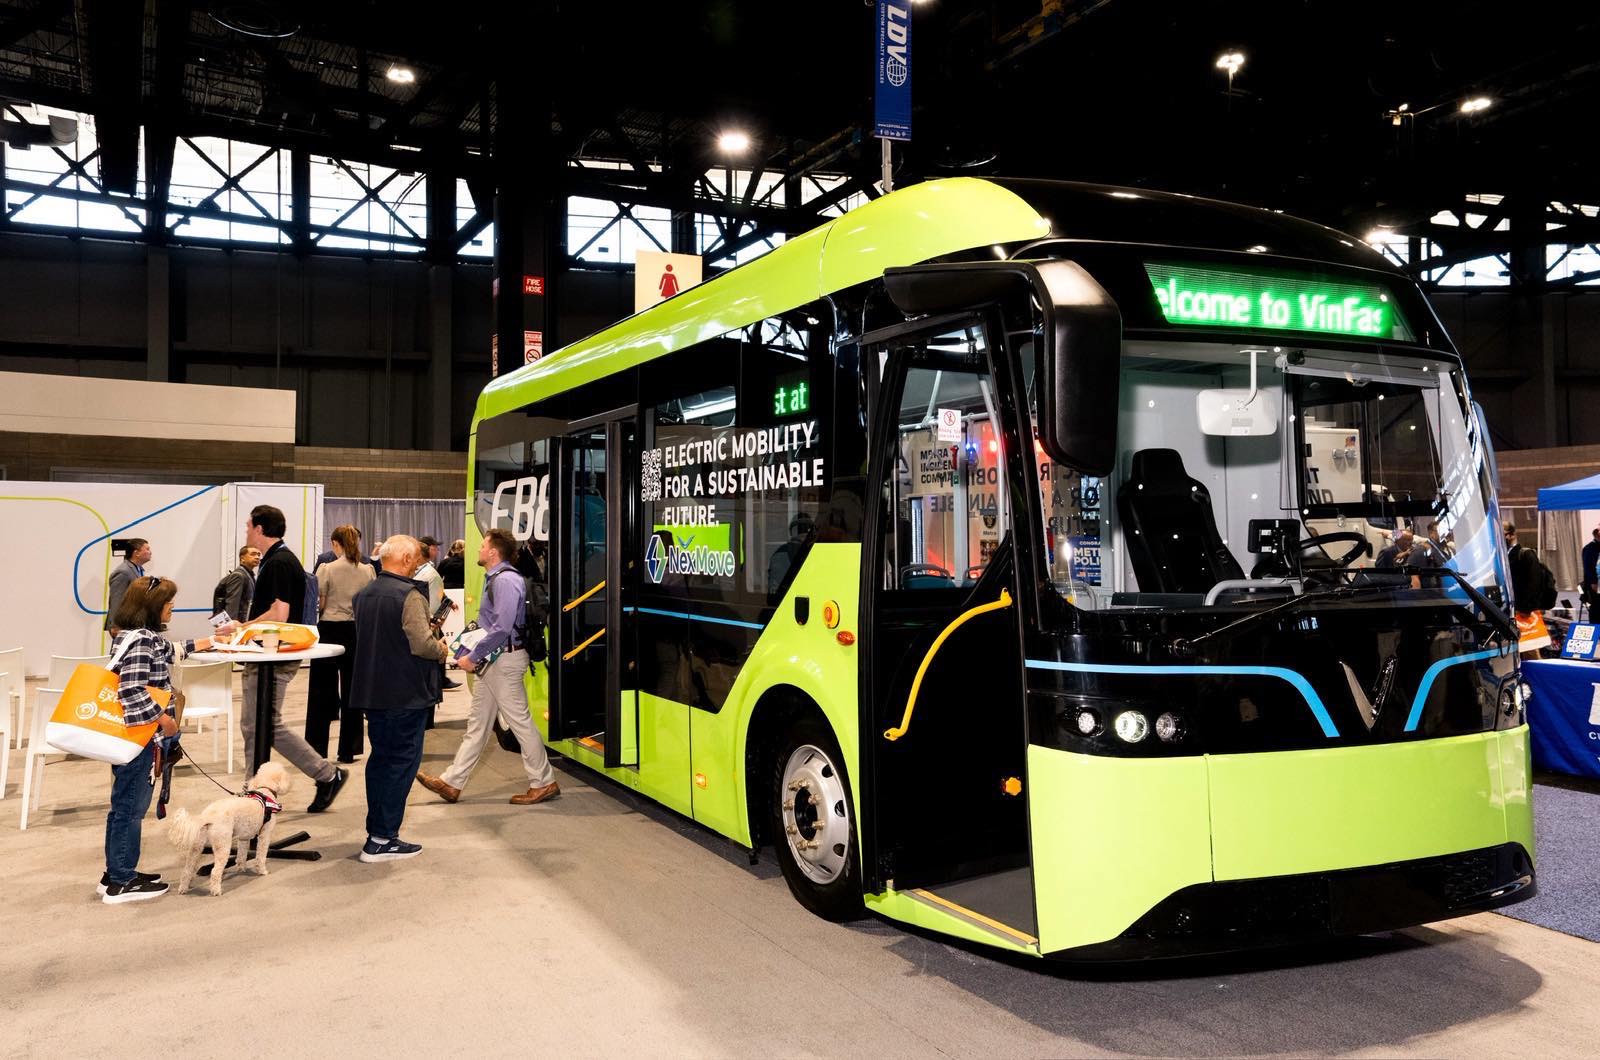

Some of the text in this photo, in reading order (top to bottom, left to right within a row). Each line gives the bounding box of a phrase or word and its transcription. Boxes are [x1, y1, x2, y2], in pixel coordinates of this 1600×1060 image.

[887, 4, 908, 66] LDV
[525, 285, 542, 293] HOSE
[526, 278, 541, 286] FIRE
[1260, 291, 1290, 326] to
[790, 382, 807, 411] at
[665, 420, 816, 468] ELECTRIC MOBILITY
[665, 458, 824, 498] FOR A SUSTAINABLE
[664, 504, 720, 528] FUTURE.
[669, 545, 735, 577] NexMove
